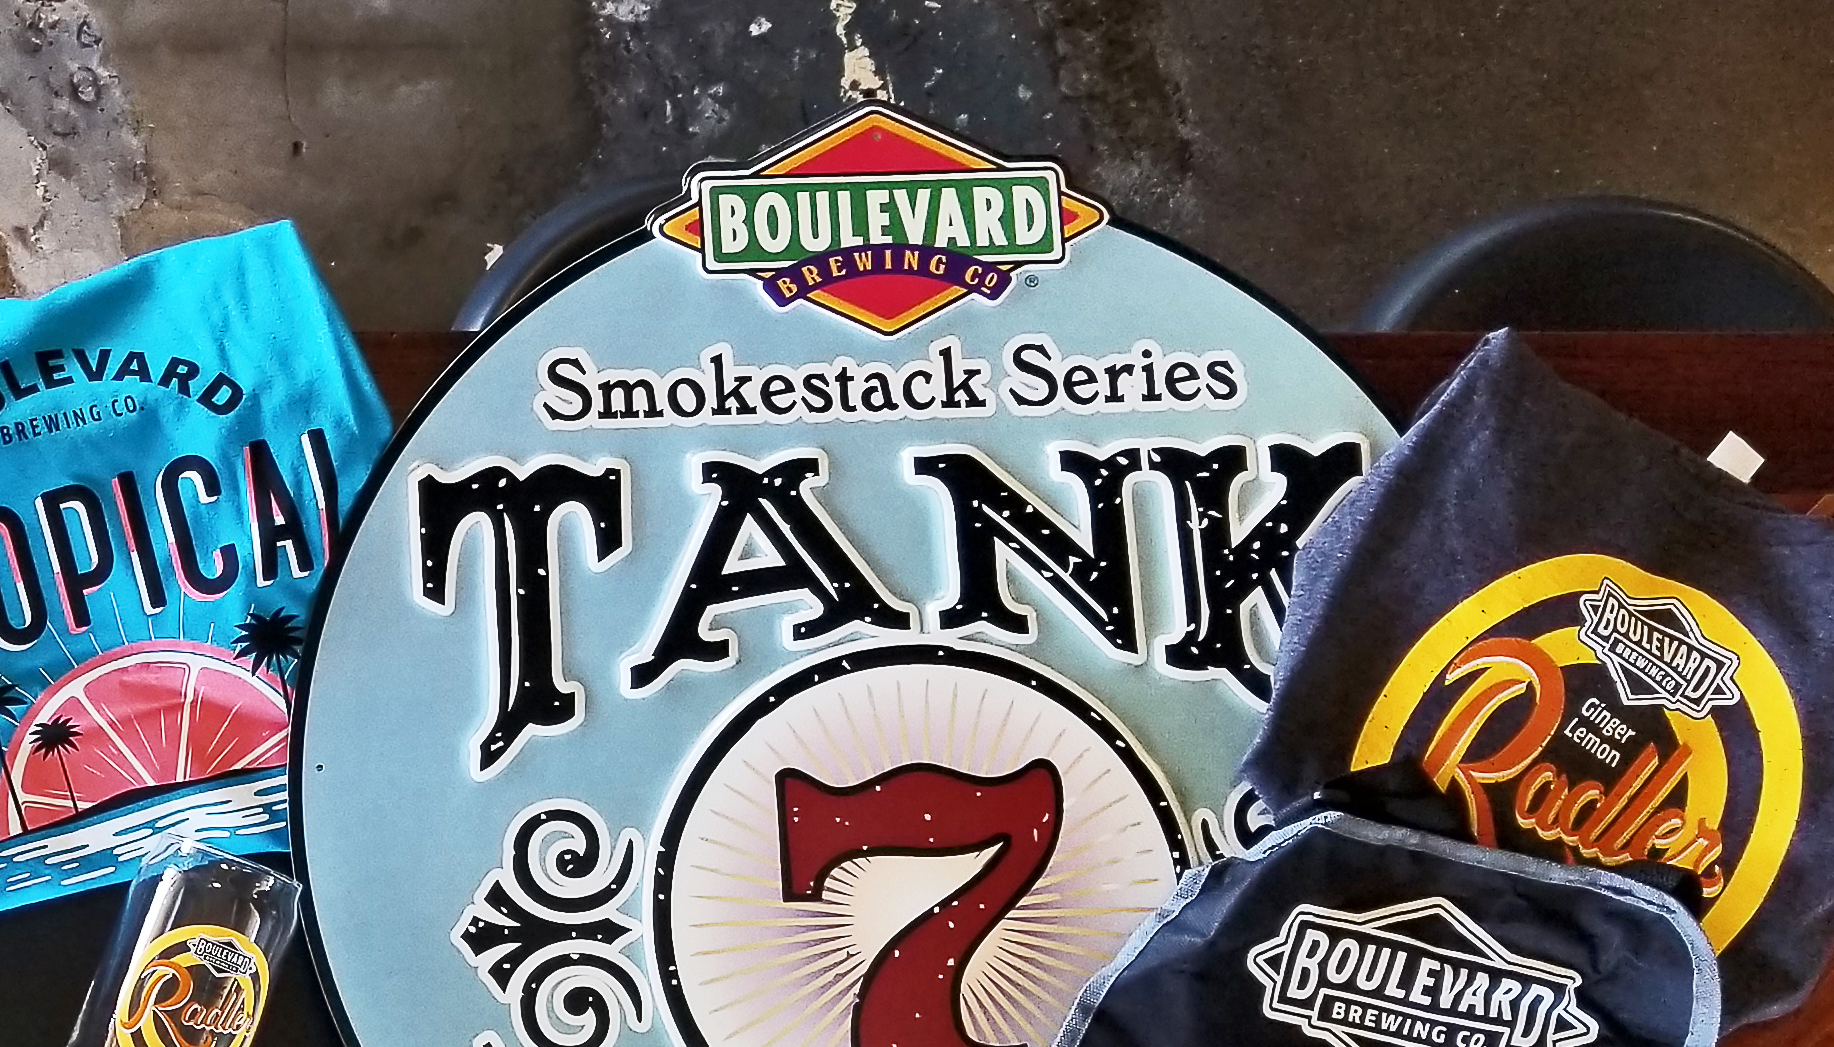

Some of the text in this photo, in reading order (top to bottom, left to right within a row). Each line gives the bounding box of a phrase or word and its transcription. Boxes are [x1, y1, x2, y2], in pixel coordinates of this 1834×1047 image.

[718, 184, 1048, 254] BOULEVARD
[776, 249, 947, 299] BREWING
[543, 343, 1239, 421] Smokestack Series
[0, 395, 146, 446] BREWING CO.
[416, 442, 1362, 772] TANK
[1597, 595, 1717, 700] BOULEVARD
[1615, 642, 1665, 682] BREWING
[1564, 717, 1621, 768] Lemon
[1581, 697, 1637, 744] Ginger
[1422, 636, 1725, 898] Radler
[196, 939, 250, 975] BOULEVARD
[1332, 1001, 1446, 1045] BREWING
